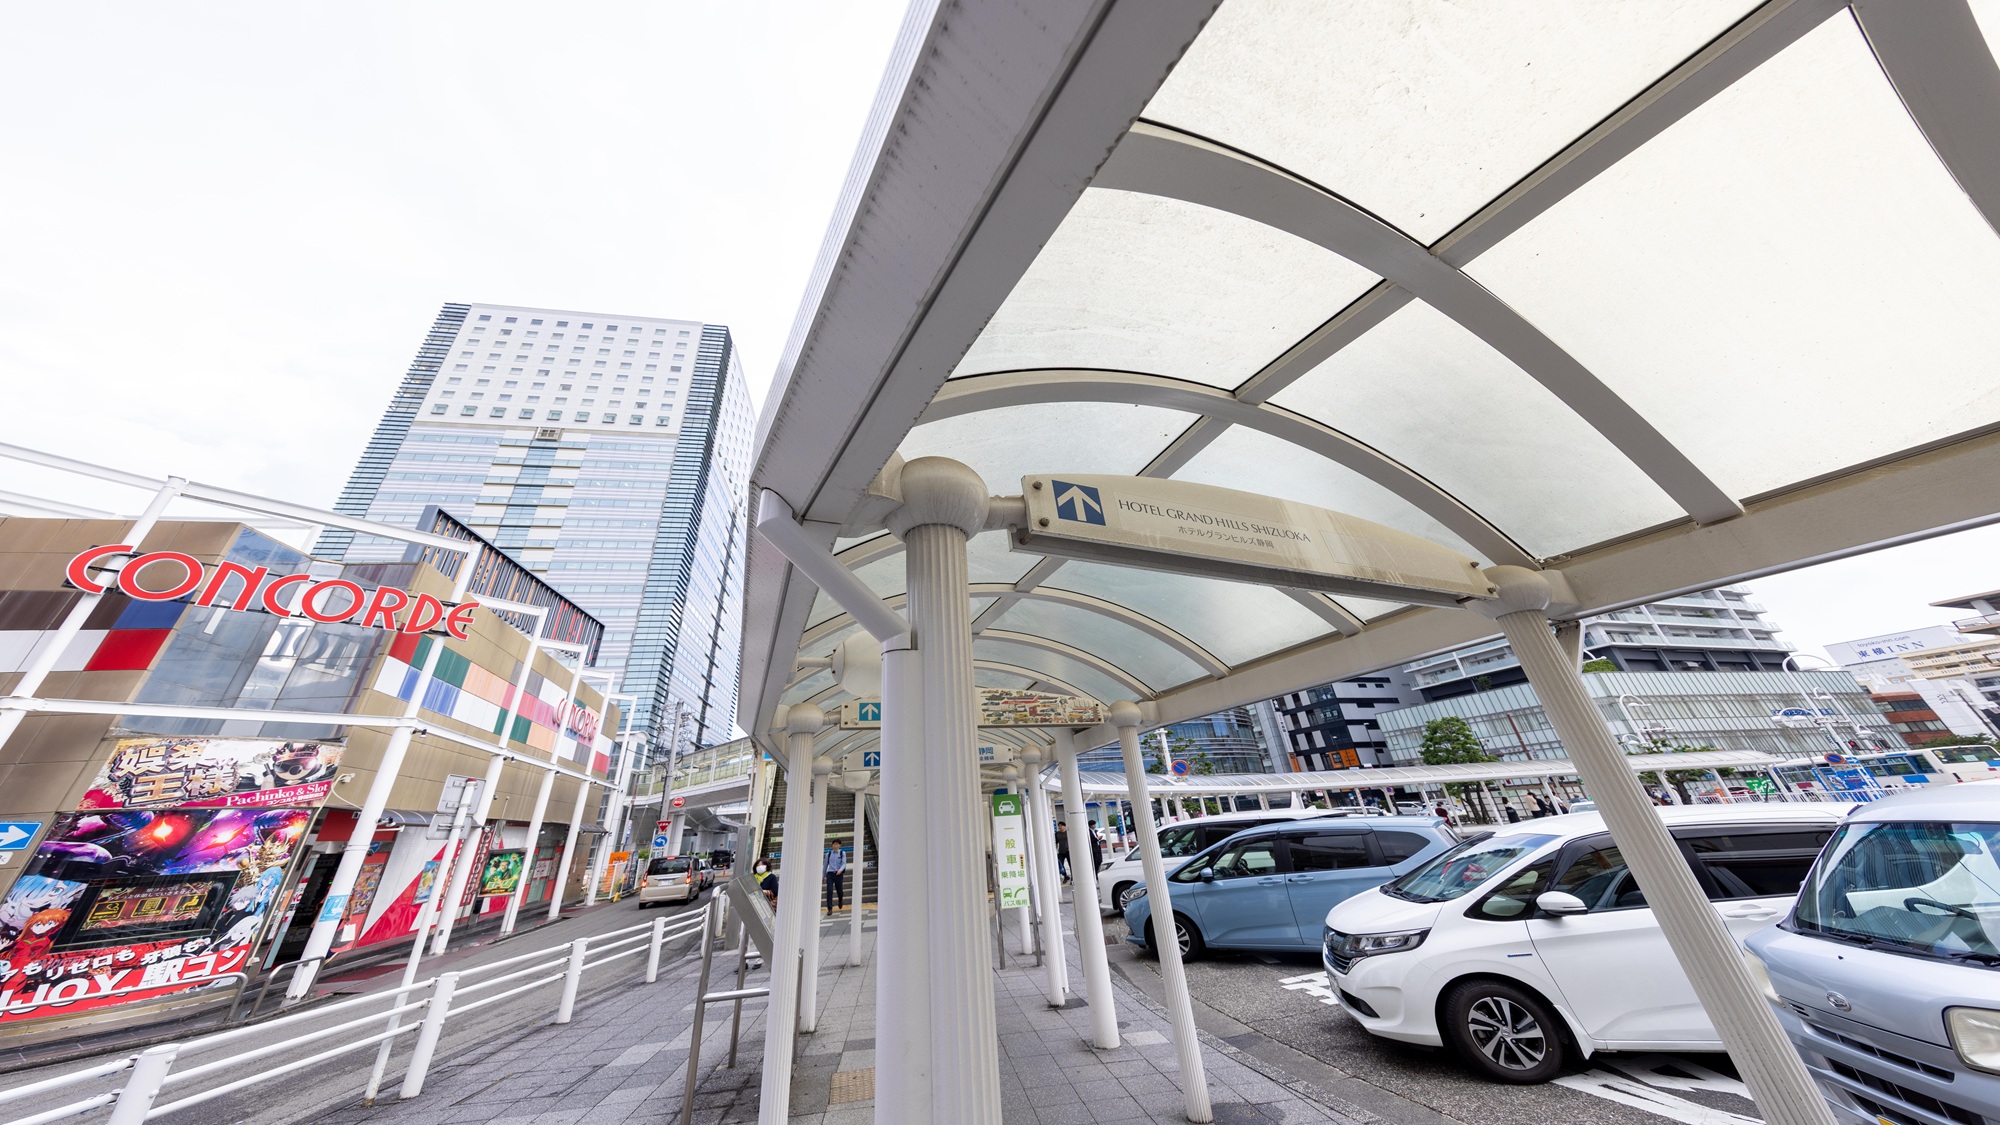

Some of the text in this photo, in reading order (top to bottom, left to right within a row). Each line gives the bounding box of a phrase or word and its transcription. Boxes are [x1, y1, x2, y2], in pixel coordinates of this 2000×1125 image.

[1118, 499, 1311, 543] HOTEL GRAND HILLS SHIZUOKA
[1178, 525, 1274, 549] ホテルグランヒルズ静岡
[66, 544, 480, 641] CONCORDE
[1857, 634, 1910, 648] toyoko-inn.com
[131, 765, 236, 804] 王様
[226, 783, 328, 807] Pachinko & Slot
[1003, 826, 1017, 865] 一般車
[1001, 870, 1025, 879] 乗降場
[1003, 898, 1028, 908] バス専用
[46, 949, 135, 980] リゼロも
[138, 949, 247, 988] 駅コン
